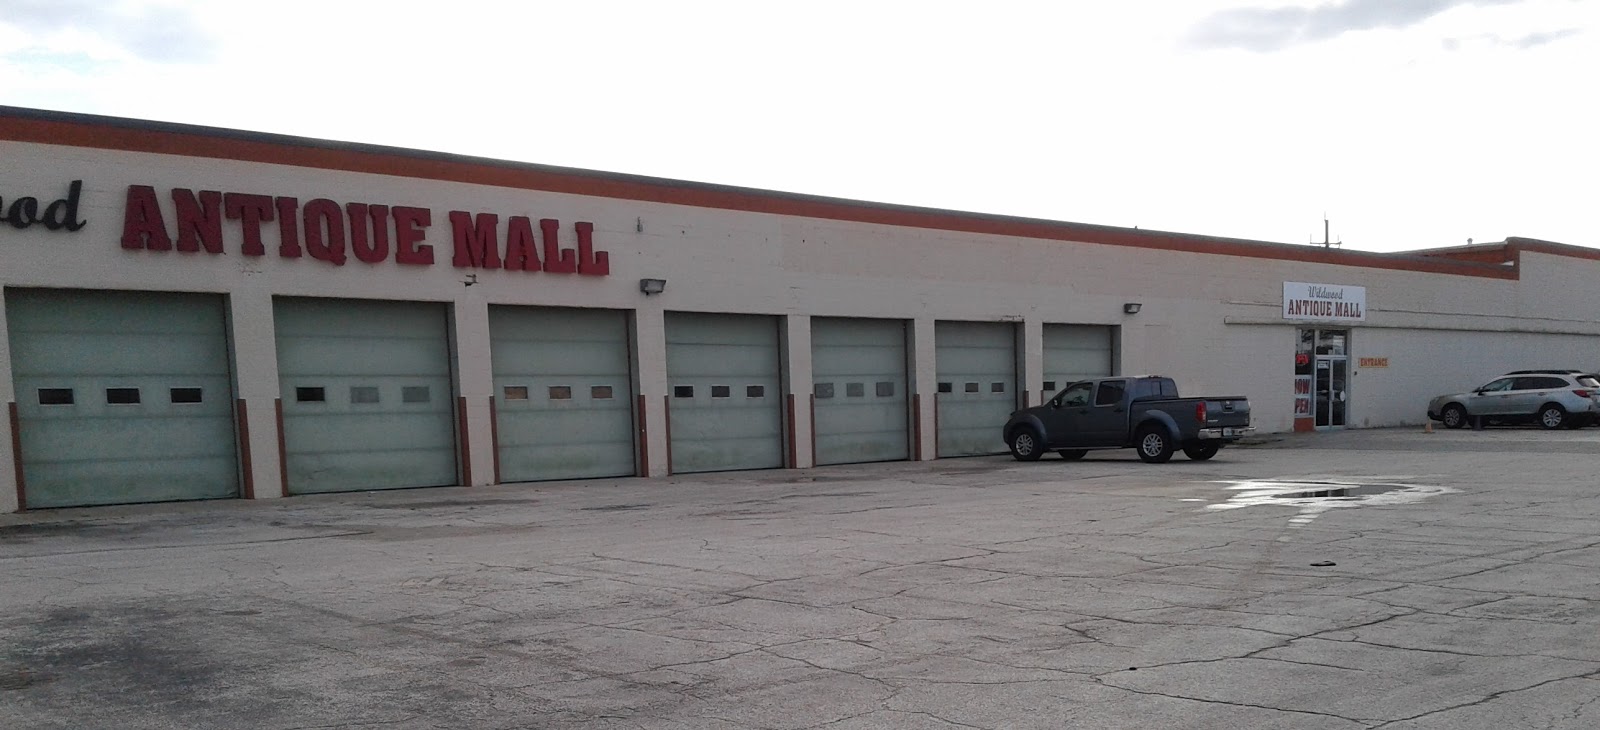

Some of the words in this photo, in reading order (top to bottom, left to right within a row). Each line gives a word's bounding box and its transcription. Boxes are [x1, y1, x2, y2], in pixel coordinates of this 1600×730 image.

[121, 184, 434, 266] ANTIQUE
[449, 210, 610, 276] MALL
[1308, 285, 1344, 300] Wildwood
[1288, 299, 1332, 317] ANTIQUE
[1335, 301, 1362, 318] MALL
[1360, 358, 1388, 367] ENTRANCE
